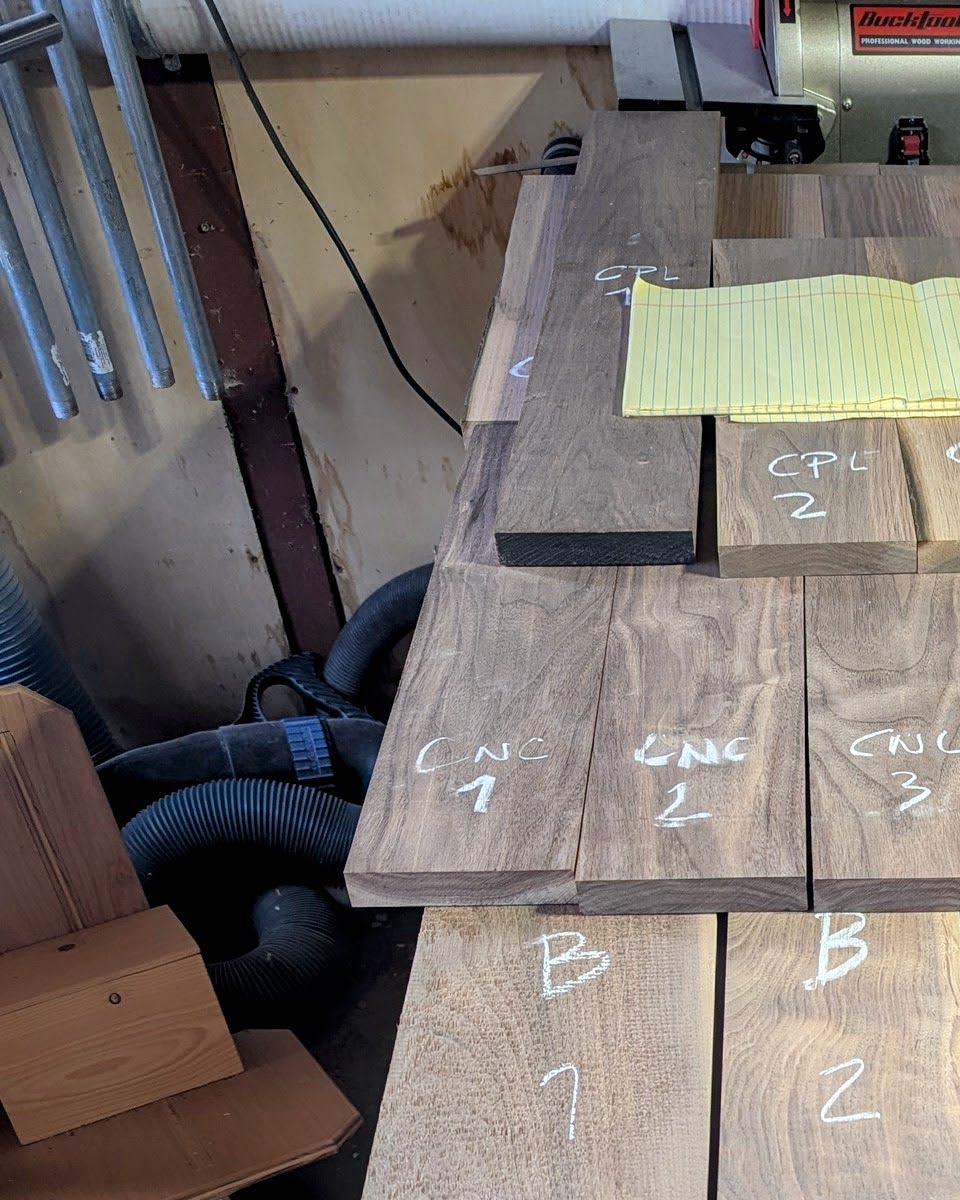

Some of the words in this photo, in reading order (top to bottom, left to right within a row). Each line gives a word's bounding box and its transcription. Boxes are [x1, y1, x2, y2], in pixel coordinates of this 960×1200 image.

[861, 37, 908, 45] PROFESSIONAL
[911, 37, 931, 45] WOOD
[768, 449, 868, 479] CPL
[772, 492, 827, 520] 2
[415, 736, 550, 774] CNC
[449, 774, 496, 813] 1
[891, 771, 932, 812] 3
[529, 931, 611, 999] B
[803, 912, 868, 990] B
[540, 1062, 579, 1140] 1
[819, 1058, 881, 1123] 2
